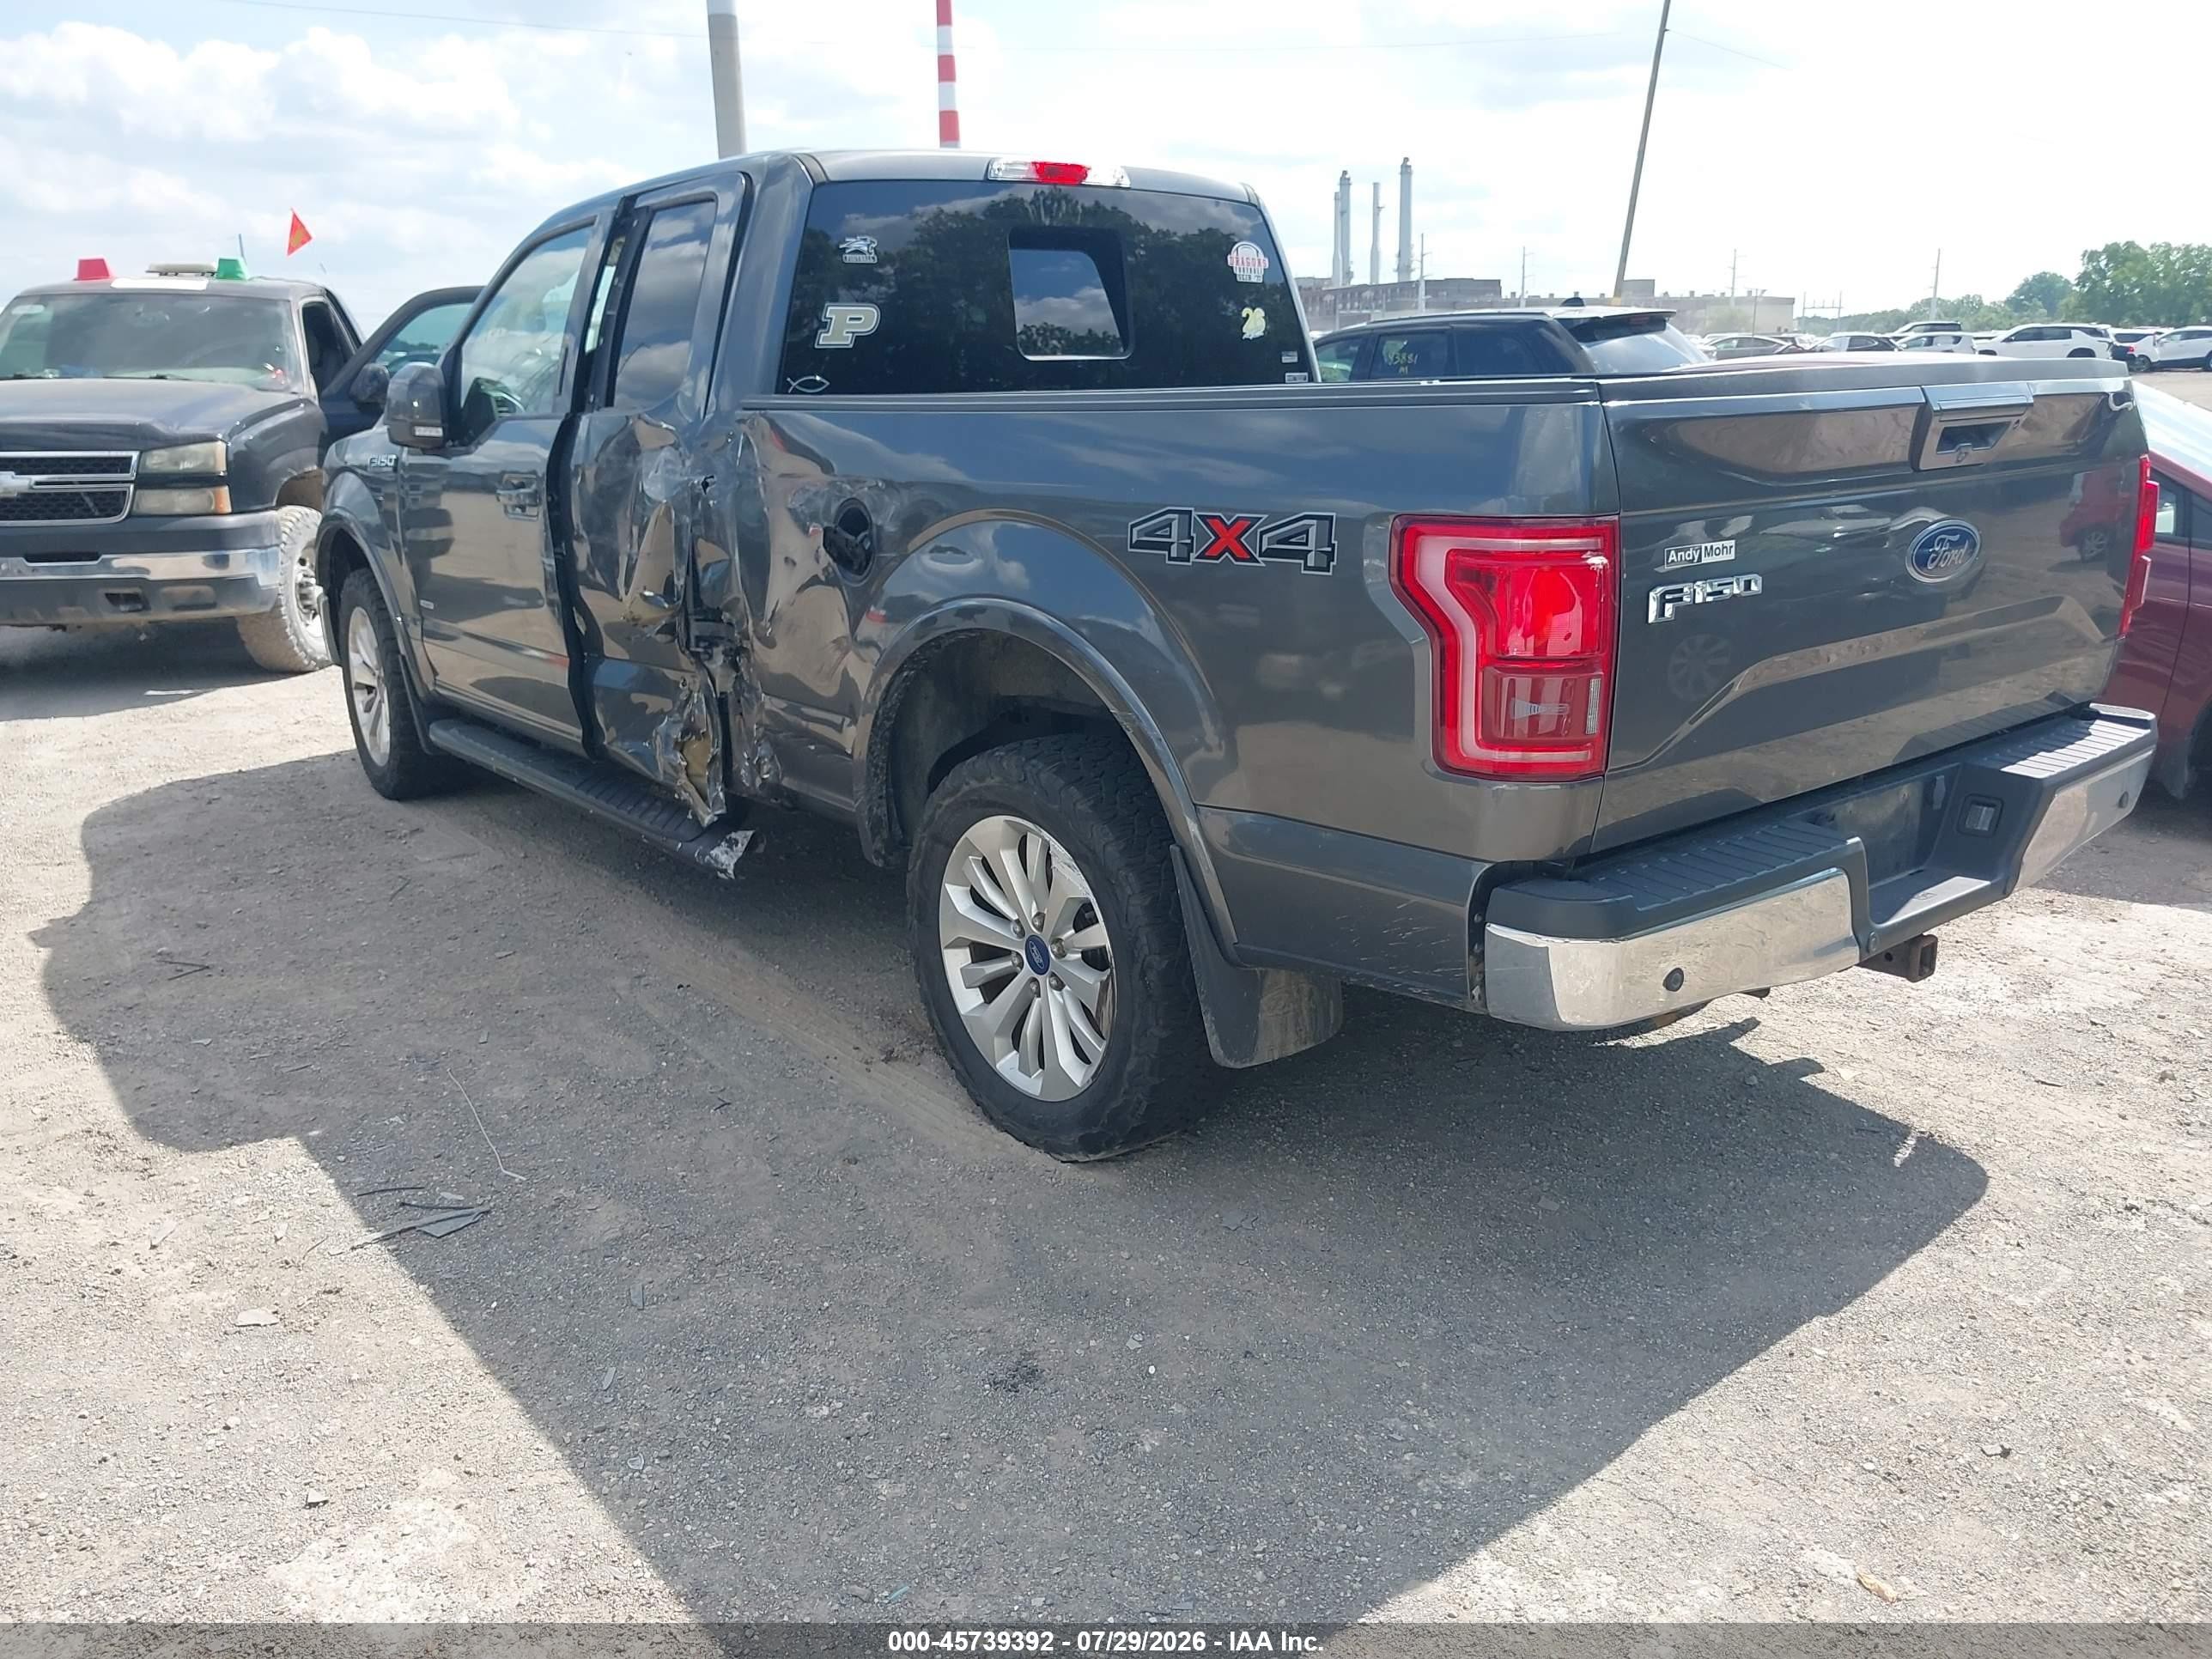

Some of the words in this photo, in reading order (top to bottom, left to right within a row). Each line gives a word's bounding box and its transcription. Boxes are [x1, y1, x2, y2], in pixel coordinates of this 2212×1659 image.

[815, 303, 880, 348] P
[1668, 548, 1700, 562] Andy
[1704, 544, 1733, 558] Mohr
[1926, 534, 1969, 569] Ford
[1648, 574, 1762, 623] F150
